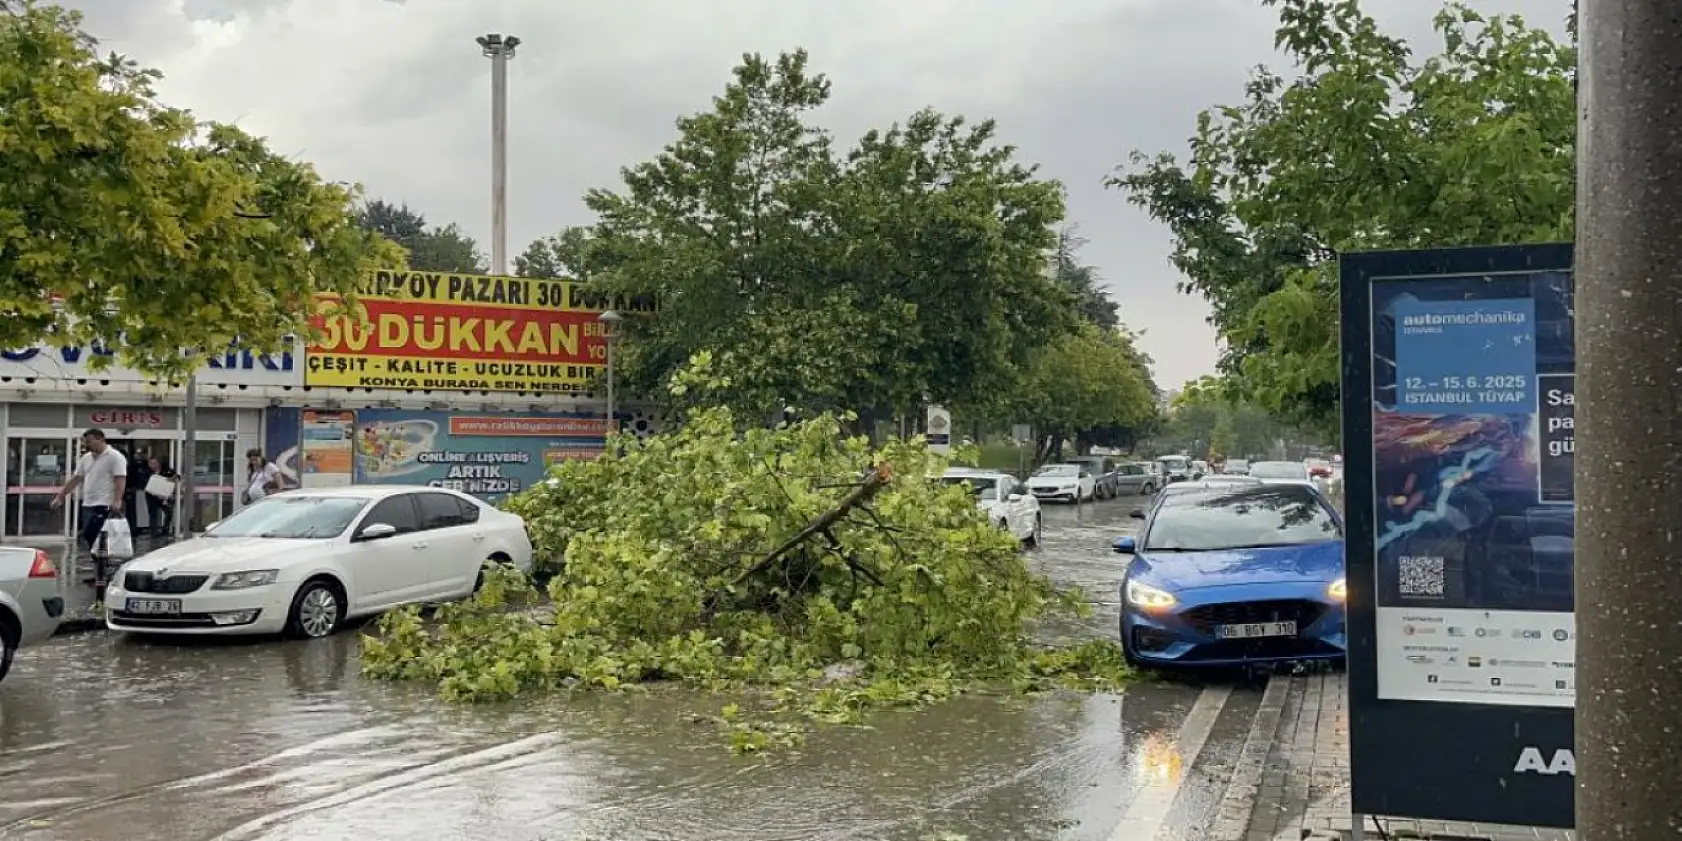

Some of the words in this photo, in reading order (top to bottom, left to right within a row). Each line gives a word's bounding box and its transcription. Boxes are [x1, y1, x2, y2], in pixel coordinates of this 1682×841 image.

[449, 276, 529, 304] PAZARI
[538, 283, 562, 307] 30
[1403, 309, 1526, 326] automechanika
[314, 301, 370, 351] 30
[379, 314, 579, 355] DÜKKAN
[586, 344, 607, 359] YO
[475, 362, 562, 379] UCUZLUK
[359, 377, 419, 387] KONYA
[424, 378, 489, 389] BURADA
[494, 381, 526, 390] SEN
[1478, 389, 1526, 403] TÜYAP
[1547, 389, 1575, 406] Sa
[1547, 416, 1575, 433] pa
[1547, 436, 1575, 456] gü
[449, 465, 501, 478] ARTIK
[1275, 622, 1295, 635] 310
[1513, 747, 1576, 776] AA
